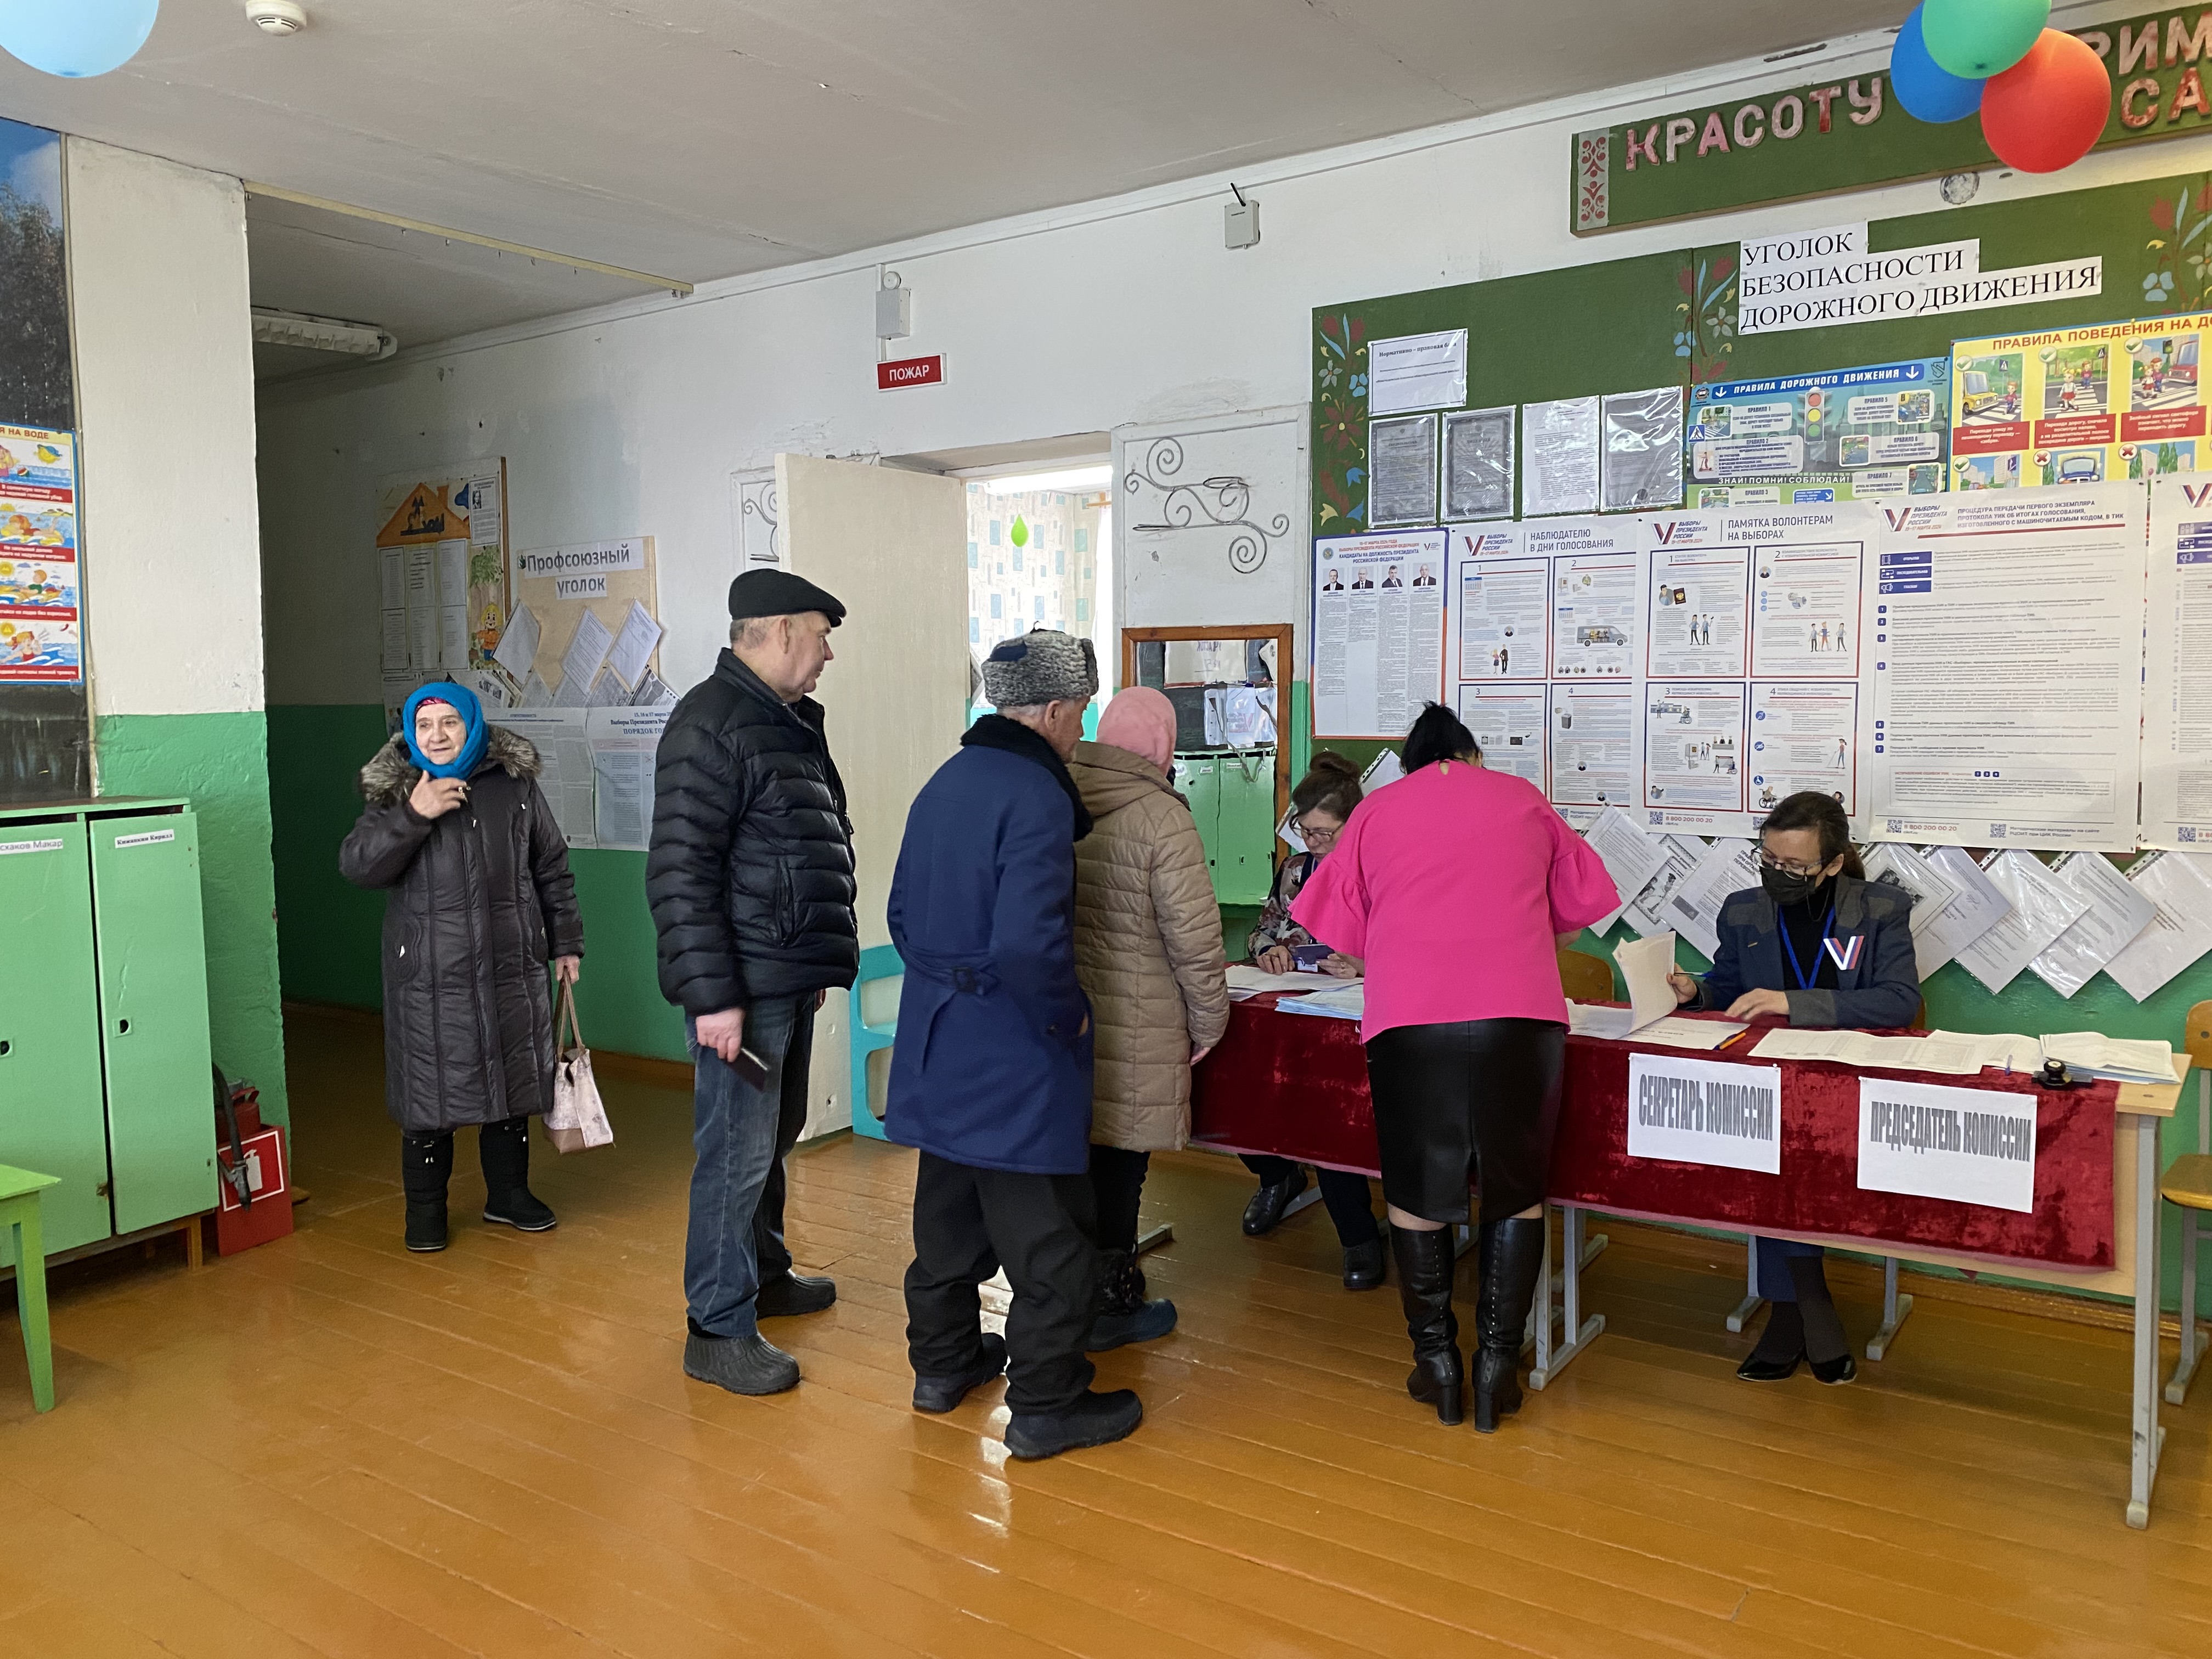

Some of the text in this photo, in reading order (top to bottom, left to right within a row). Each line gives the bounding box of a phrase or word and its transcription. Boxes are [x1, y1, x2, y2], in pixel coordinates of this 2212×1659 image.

[1626, 77, 1883, 171] КРАСОТУ
[1743, 232, 1852, 266] УГОЛОК
[1742, 250, 1963, 297] БЕЗОПАСНОСТИ
[1740, 266, 2097, 330] ДОРОЖНОГО ДВИЖЕНИЯ
[1993, 334, 2062, 349] ПРАВИЛА
[2068, 321, 2164, 342] ПОВЕДЕНИЯ
[2171, 318, 2192, 330] НА
[1379, 348, 1412, 357] Нормативно
[1417, 345, 1443, 353] правовая
[889, 365, 929, 381] ПОЖАР
[1734, 369, 1899, 394] ПРАВИЛА ДОРОЖНОГО ДВИЖЕНИЯ
[24, 430, 49, 439] ВОДЕ
[1790, 475, 1849, 484] СОБЛЮДАЙ!
[2040, 508, 2086, 516] ГОЛОСОВАНИЯ,
[1728, 515, 1833, 529] ПАМЯТКА ВОЛОНТЕРАМ
[2017, 516, 2079, 524] МАШИНОЧИТАЕМЫМ
[1531, 529, 1590, 541] НАБЛЮДАТЕЛЮ
[1728, 530, 1784, 541] НА ВЫБОРАХ
[1537, 543, 1554, 552] ДНИ
[1556, 539, 1613, 550] ГОЛОСОВАНИЯ
[527, 544, 630, 574] Профсоюзный
[557, 578, 606, 599] уголок
[150, 832, 173, 840] Кирилл
[33, 840, 63, 849] Макар
[1639, 1074, 1773, 1141] СЕКРЕТАРЬ КОМИССИИ
[1870, 1101, 2032, 1163] ПРЕДСЕДАТЕЛЬ КОМИССИИ
